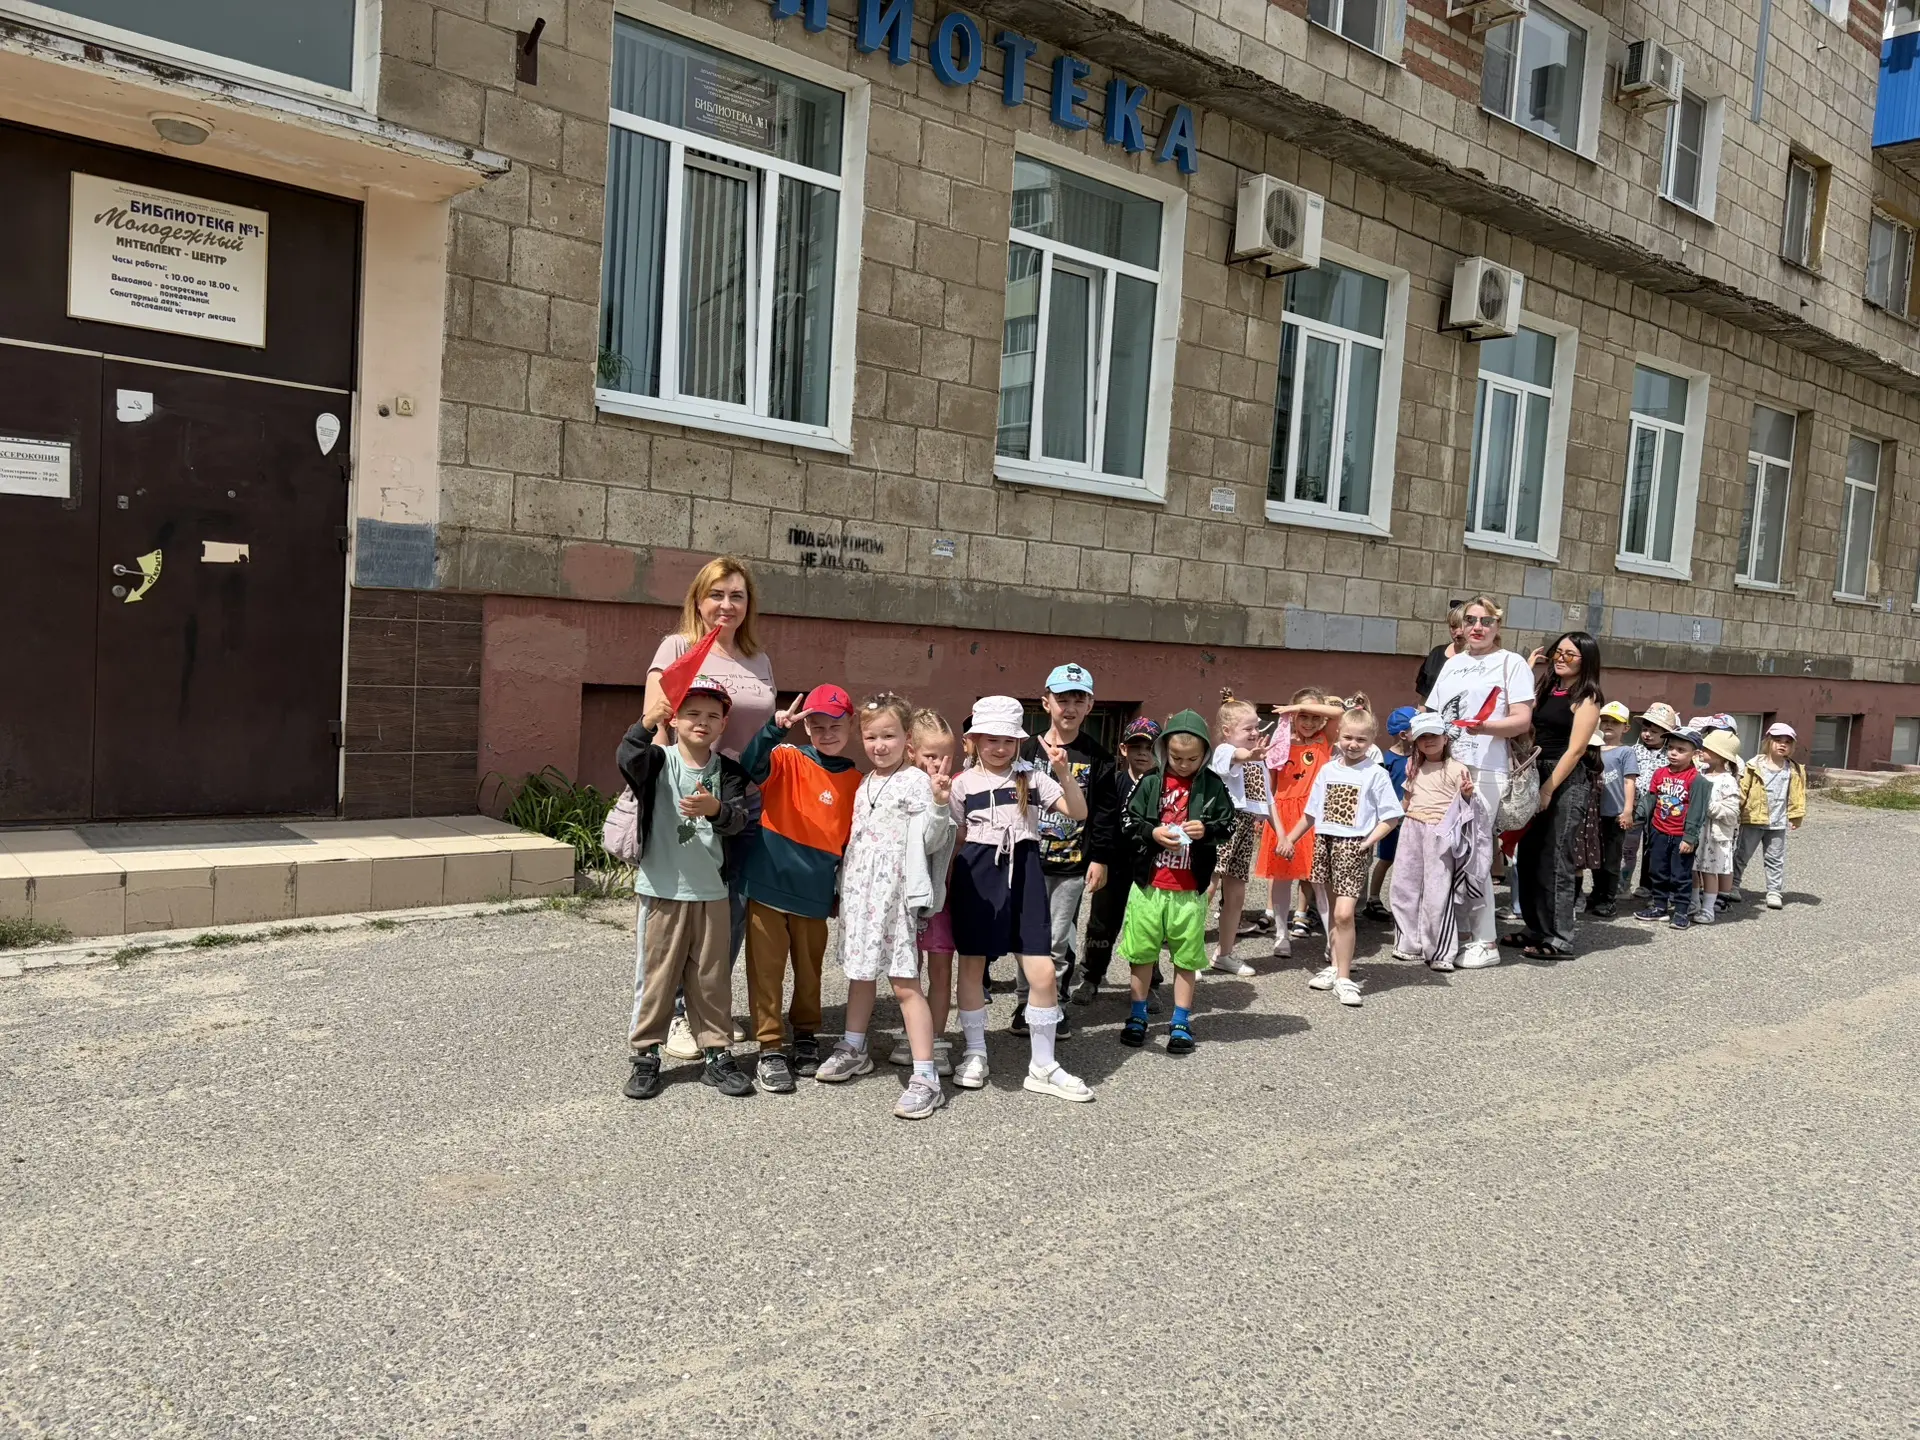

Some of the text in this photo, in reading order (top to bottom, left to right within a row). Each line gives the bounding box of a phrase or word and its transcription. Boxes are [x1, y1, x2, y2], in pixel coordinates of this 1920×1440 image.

[695, 98, 753, 125] БИБЛИОТЕКА
[130, 200, 234, 233] БИБЛИОТЕКА
[94, 206, 244, 252] Молодежный
[116, 236, 182, 257] ИНТЕЛЛЕКТ
[192, 250, 227, 265] ЦЕНТР
[112, 254, 167, 271] Часы работы:
[111, 273, 153, 287] Выходной
[160, 283, 208, 297] воскресенье
[171, 273, 195, 284] 10.00
[209, 280, 231, 290] 18.00
[110, 288, 159, 303] Санитарный
[159, 290, 210, 304] понедельник
[131, 300, 236, 323] последний четверг месяца
[788, 528, 815, 548] ПОД
[147, 550, 161, 584] ОТКРЫТЬ
[801, 551, 818, 568] НЕ
